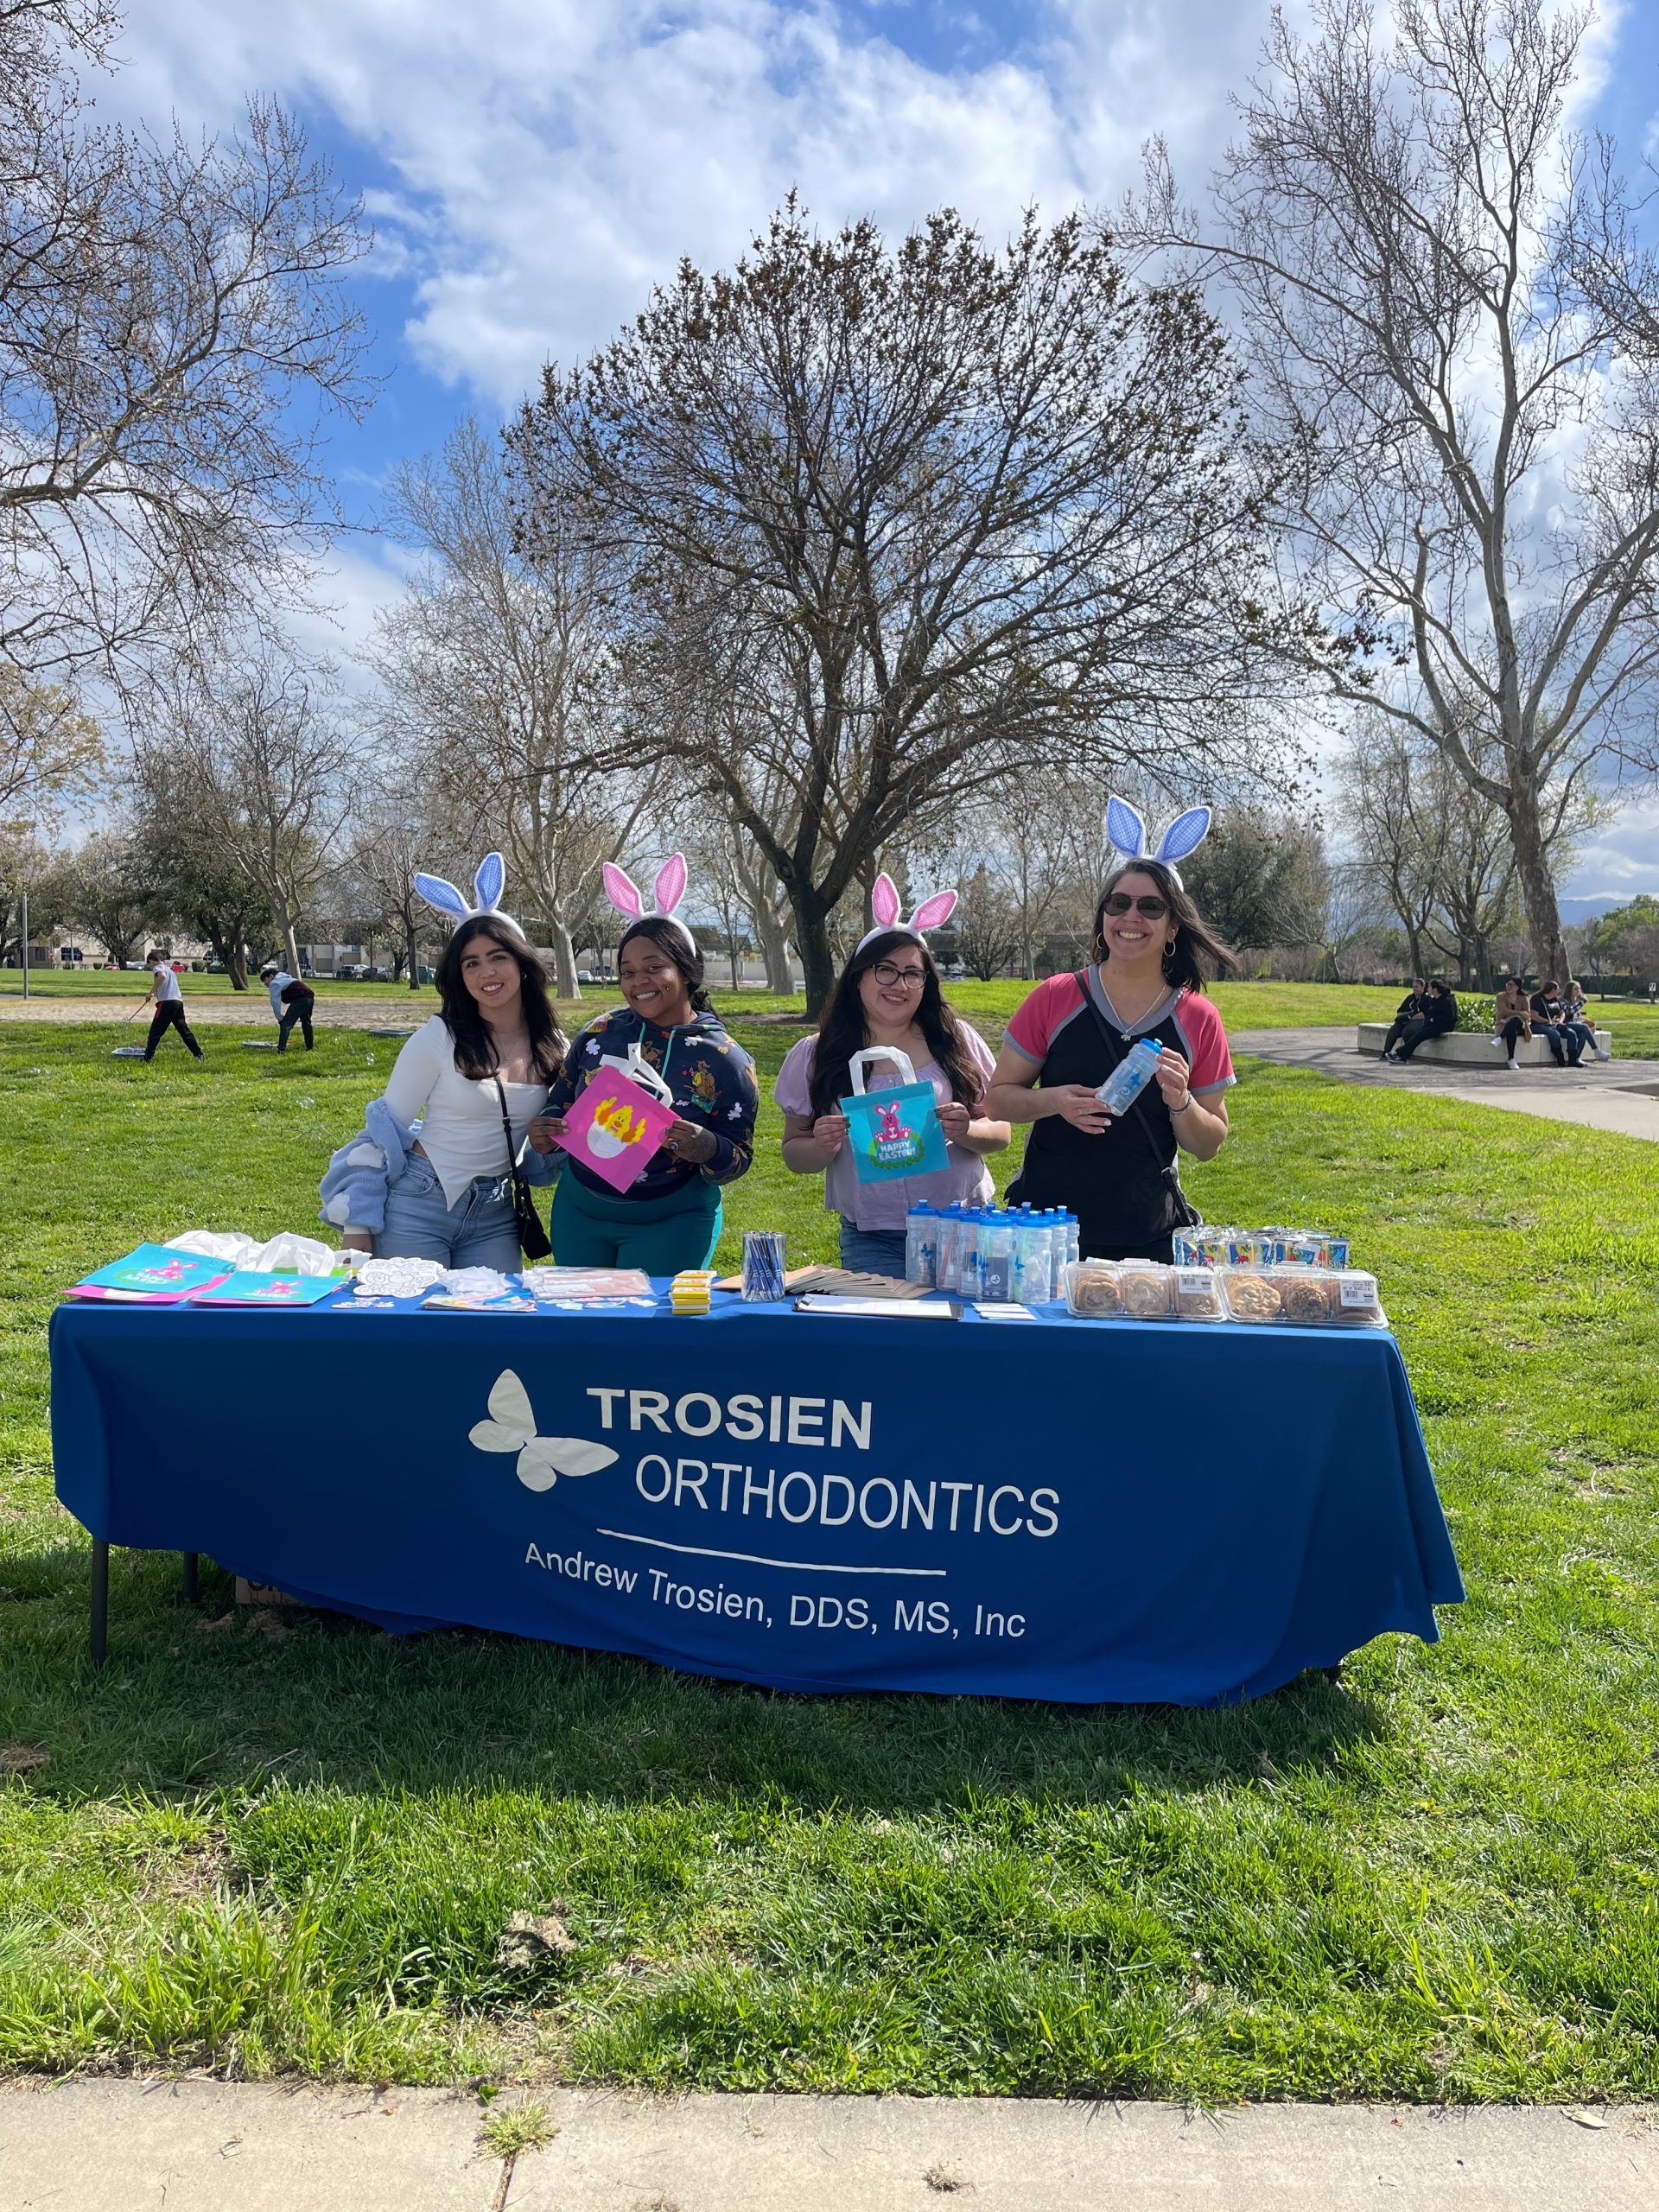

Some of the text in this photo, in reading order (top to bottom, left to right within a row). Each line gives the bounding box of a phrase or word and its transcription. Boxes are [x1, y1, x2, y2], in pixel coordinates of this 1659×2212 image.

[878, 1147, 916, 1160] EASTER!
[880, 1140, 911, 1153] HAPPY
[586, 1388, 872, 1450] TROSIEN
[635, 1454, 1060, 1537] ORTHODONTICS
[524, 1542, 1026, 1640] Andrew Trosien, DDS, MS, Inc
